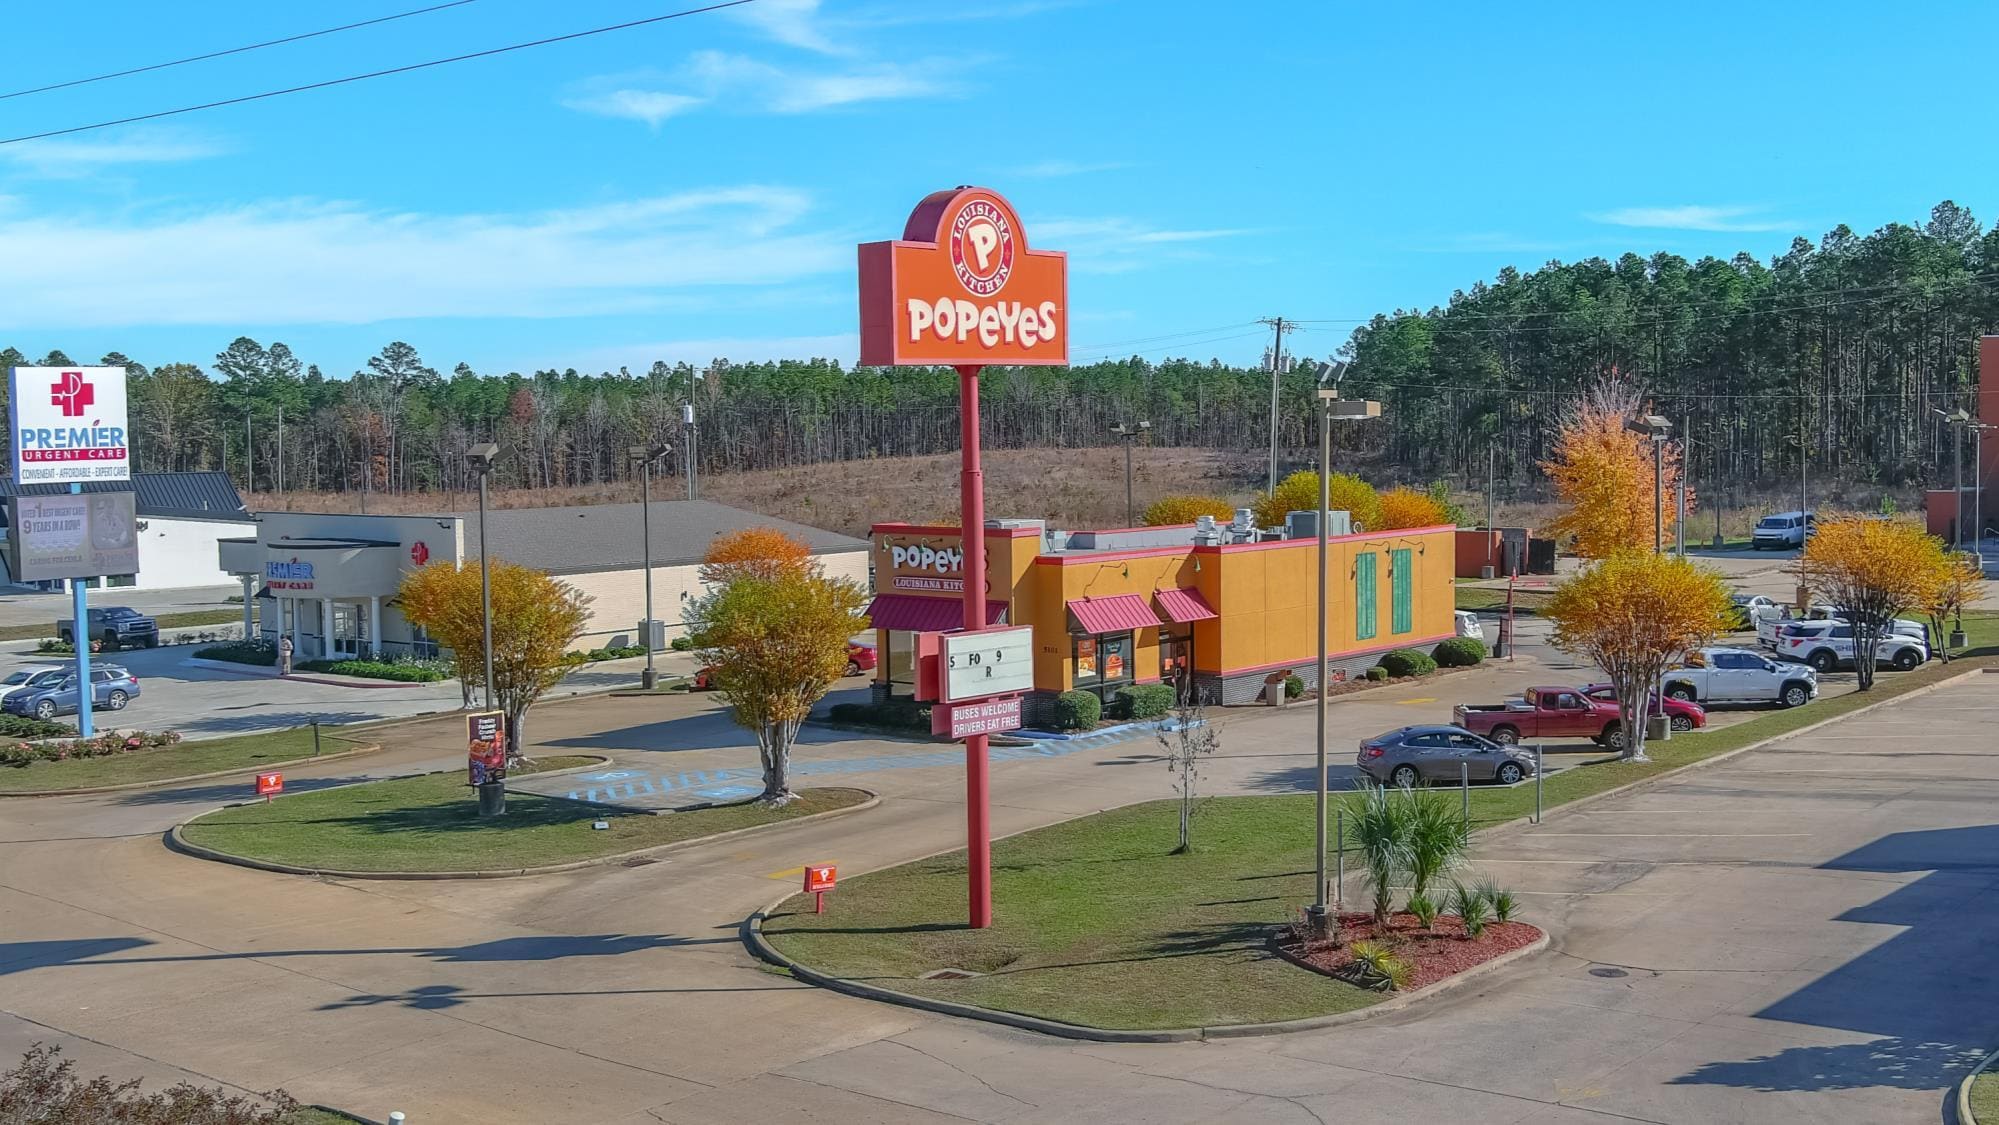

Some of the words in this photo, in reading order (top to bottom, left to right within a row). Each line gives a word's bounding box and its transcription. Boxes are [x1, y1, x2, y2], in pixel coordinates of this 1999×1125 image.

[953, 203, 1010, 243] LOUISIANA
[967, 223, 998, 271] P
[956, 262, 1009, 296] KITCHEN
[25, 450, 80, 460] URGENT
[88, 449, 122, 458] CARE
[895, 579, 940, 589] LOUISIANA
[950, 655, 956, 668] S
[996, 650, 1002, 662] 9
[985, 665, 992, 678] R
[954, 706, 980, 721] BUSES
[981, 701, 1019, 717] WELCOME
[954, 721, 986, 735] DRIVERS
[987, 719, 1000, 730] EAT
[1001, 716, 1019, 727] FREE
